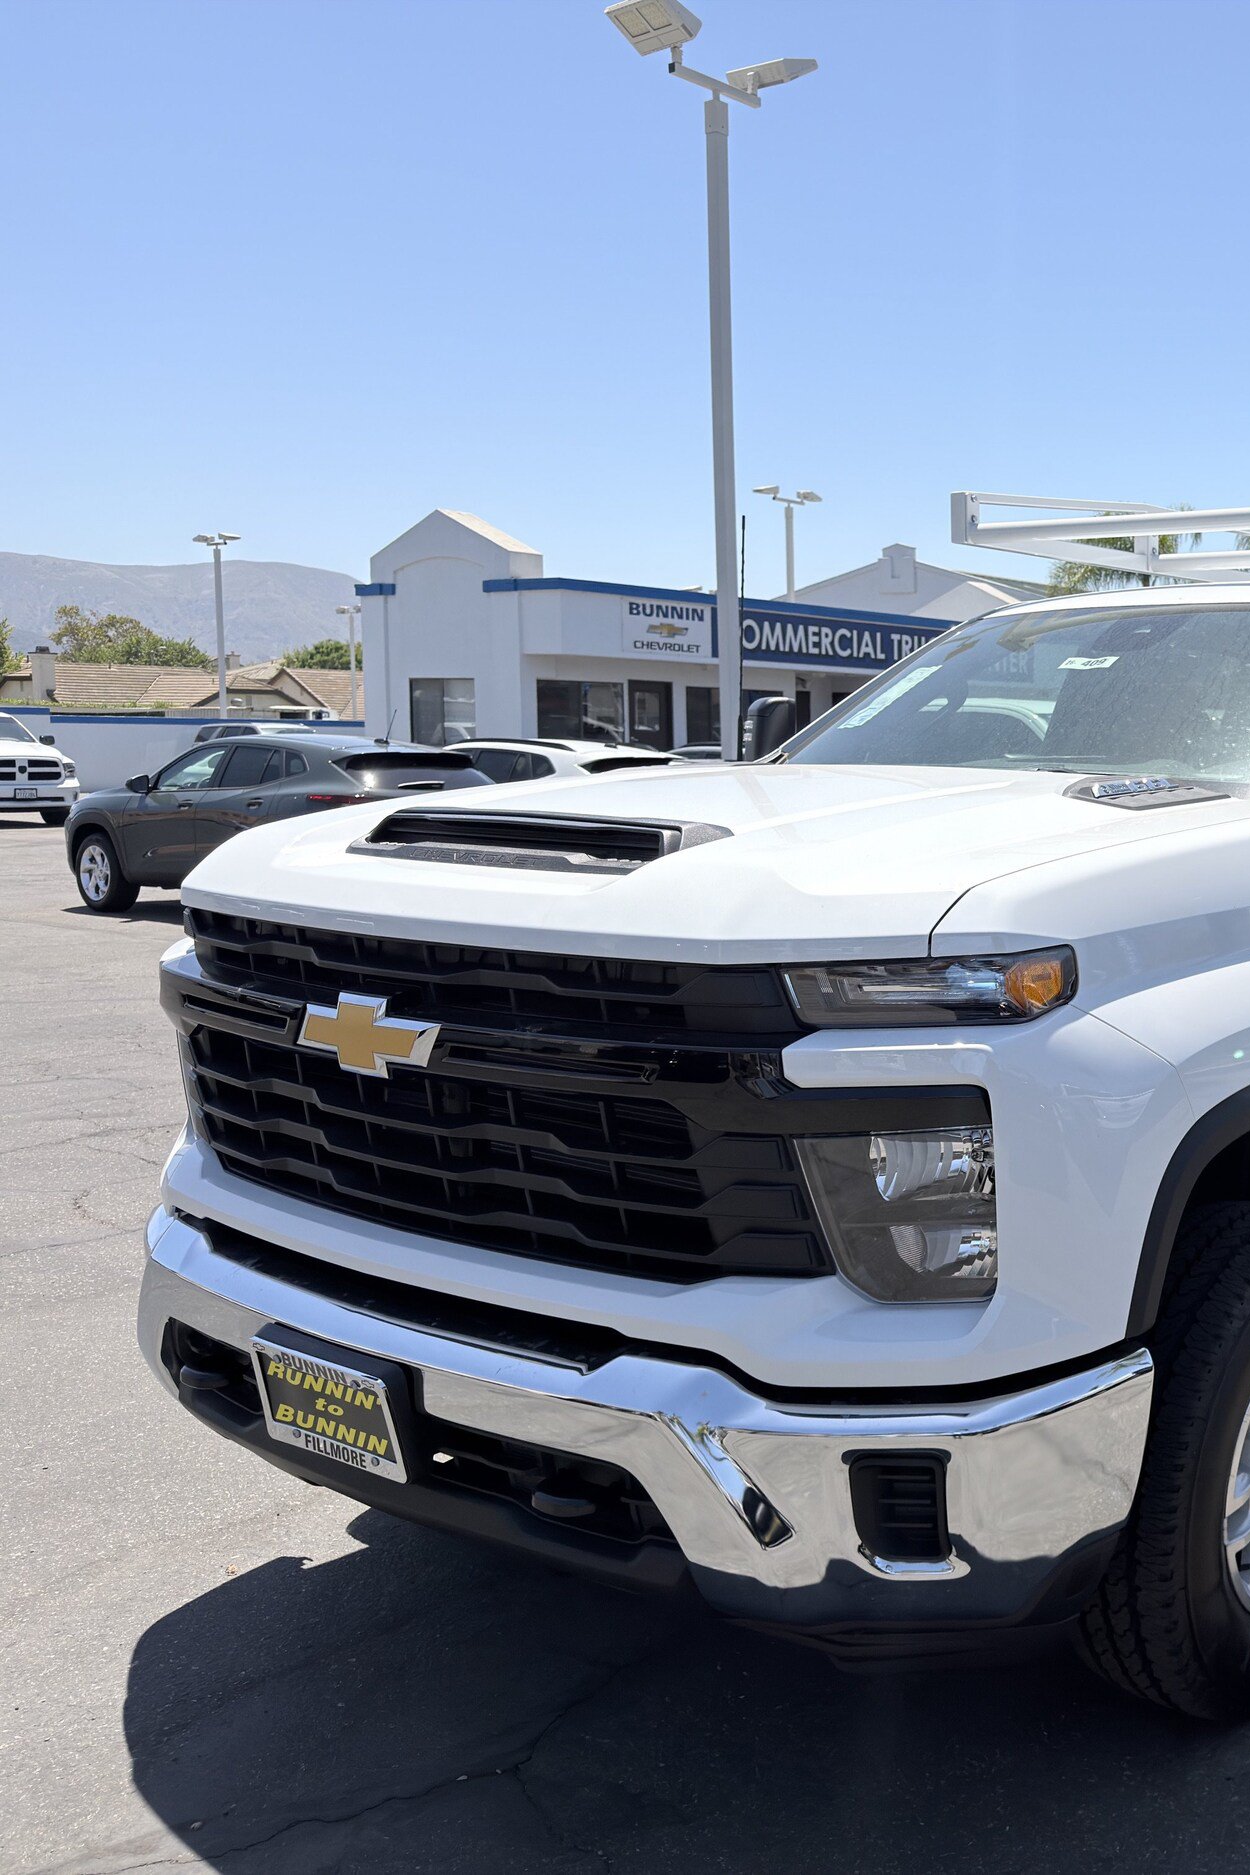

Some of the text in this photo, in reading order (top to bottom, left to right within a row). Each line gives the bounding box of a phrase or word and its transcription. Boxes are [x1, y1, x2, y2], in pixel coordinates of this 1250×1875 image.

[628, 602, 705, 622] BUNNIN
[633, 640, 701, 654] CHEVROLET
[741, 618, 938, 660] OMMERCIAL TRU
[411, 848, 545, 867] CHEVROLET
[280, 1351, 348, 1385] BUNNIN
[315, 1397, 344, 1417] to
[275, 1403, 388, 1456] BUNNIN
[304, 1433, 368, 1469] FILLMORE
